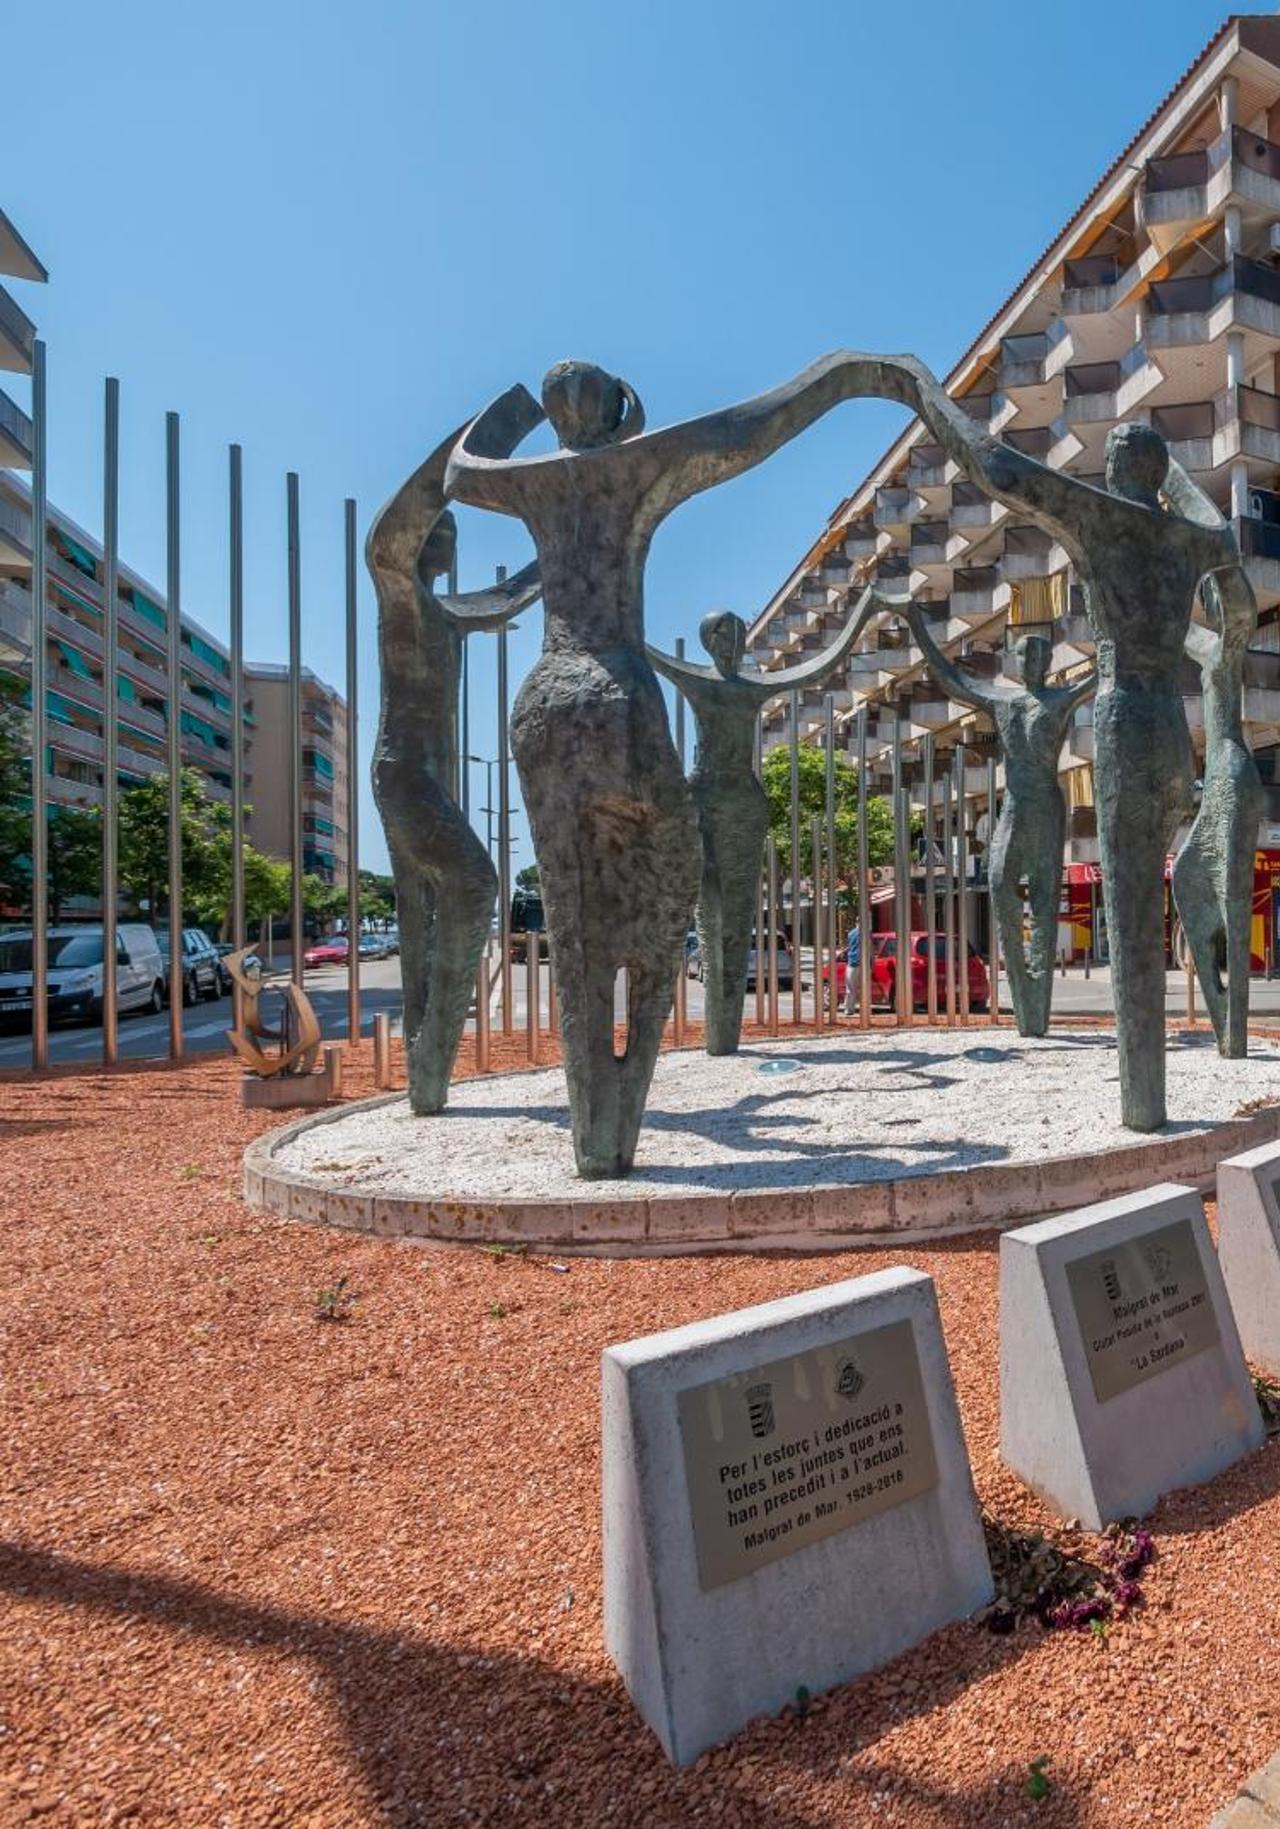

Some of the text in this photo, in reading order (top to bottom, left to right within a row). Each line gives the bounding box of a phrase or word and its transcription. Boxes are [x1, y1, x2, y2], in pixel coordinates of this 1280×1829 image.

[719, 1403, 904, 1484] Per l'esforç i dedicació a
[727, 1423, 904, 1504] totes les juntes que ens
[727, 1504, 765, 1528] han
[764, 1475, 827, 1517] precedit
[831, 1469, 836, 1487] i
[840, 1466, 850, 1481] a
[743, 1517, 793, 1550] Malgrat
[797, 1510, 812, 1527] de
